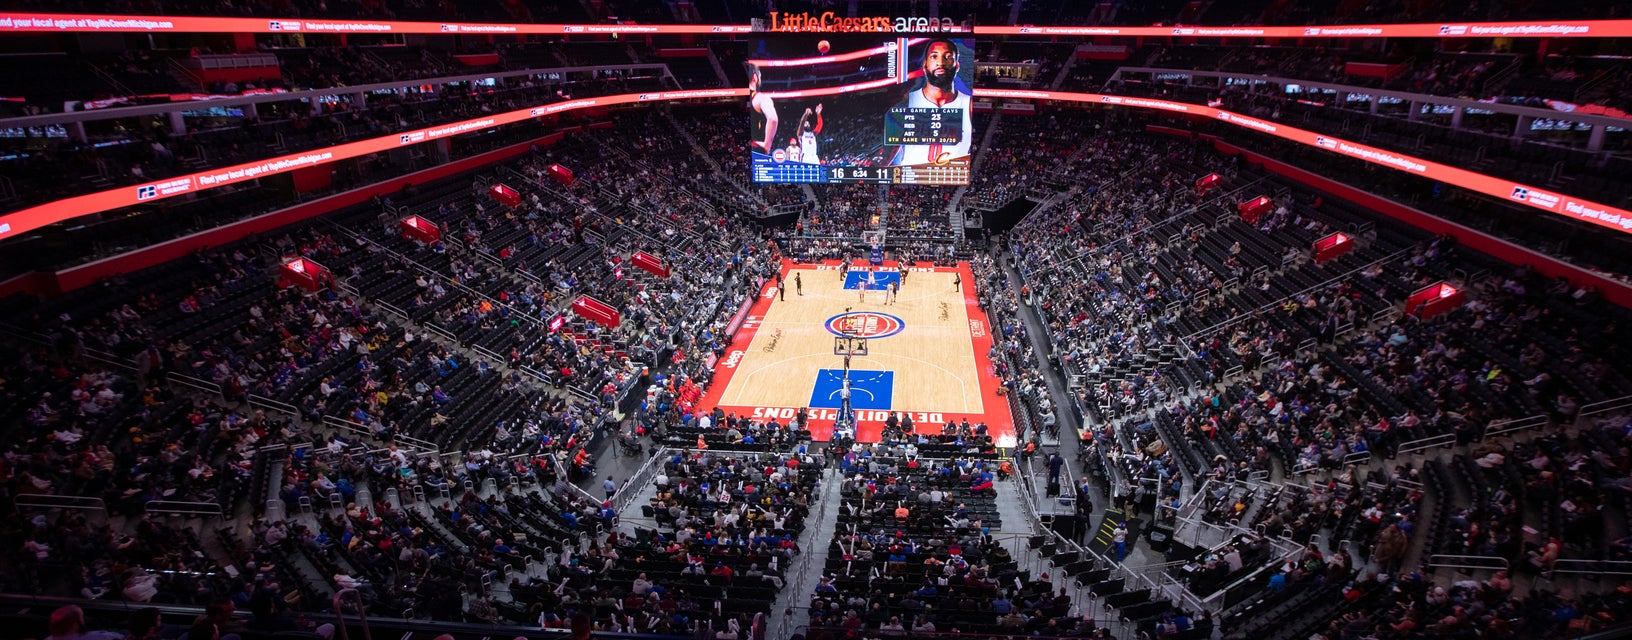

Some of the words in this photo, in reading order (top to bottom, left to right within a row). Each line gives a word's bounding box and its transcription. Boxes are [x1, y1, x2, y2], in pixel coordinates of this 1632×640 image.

[14, 19, 31, 28] your
[32, 18, 53, 27] local
[54, 19, 77, 29] agent
[78, 19, 86, 27] at
[769, 11, 818, 32] Little
[820, 11, 890, 32] Caesars
[895, 16, 953, 32] arena
[887, 42, 896, 77] DRUMMOD
[199, 175, 216, 185] Find
[214, 173, 230, 184] your
[228, 169, 245, 179] local
[244, 165, 262, 177] agent
[832, 168, 844, 179] 16
[876, 169, 888, 179] 11
[1565, 201, 1584, 214] Find
[1581, 207, 1600, 218] your
[1599, 210, 1621, 224] local
[721, 350, 745, 368] Jeep
[751, 407, 837, 420] PISONS
